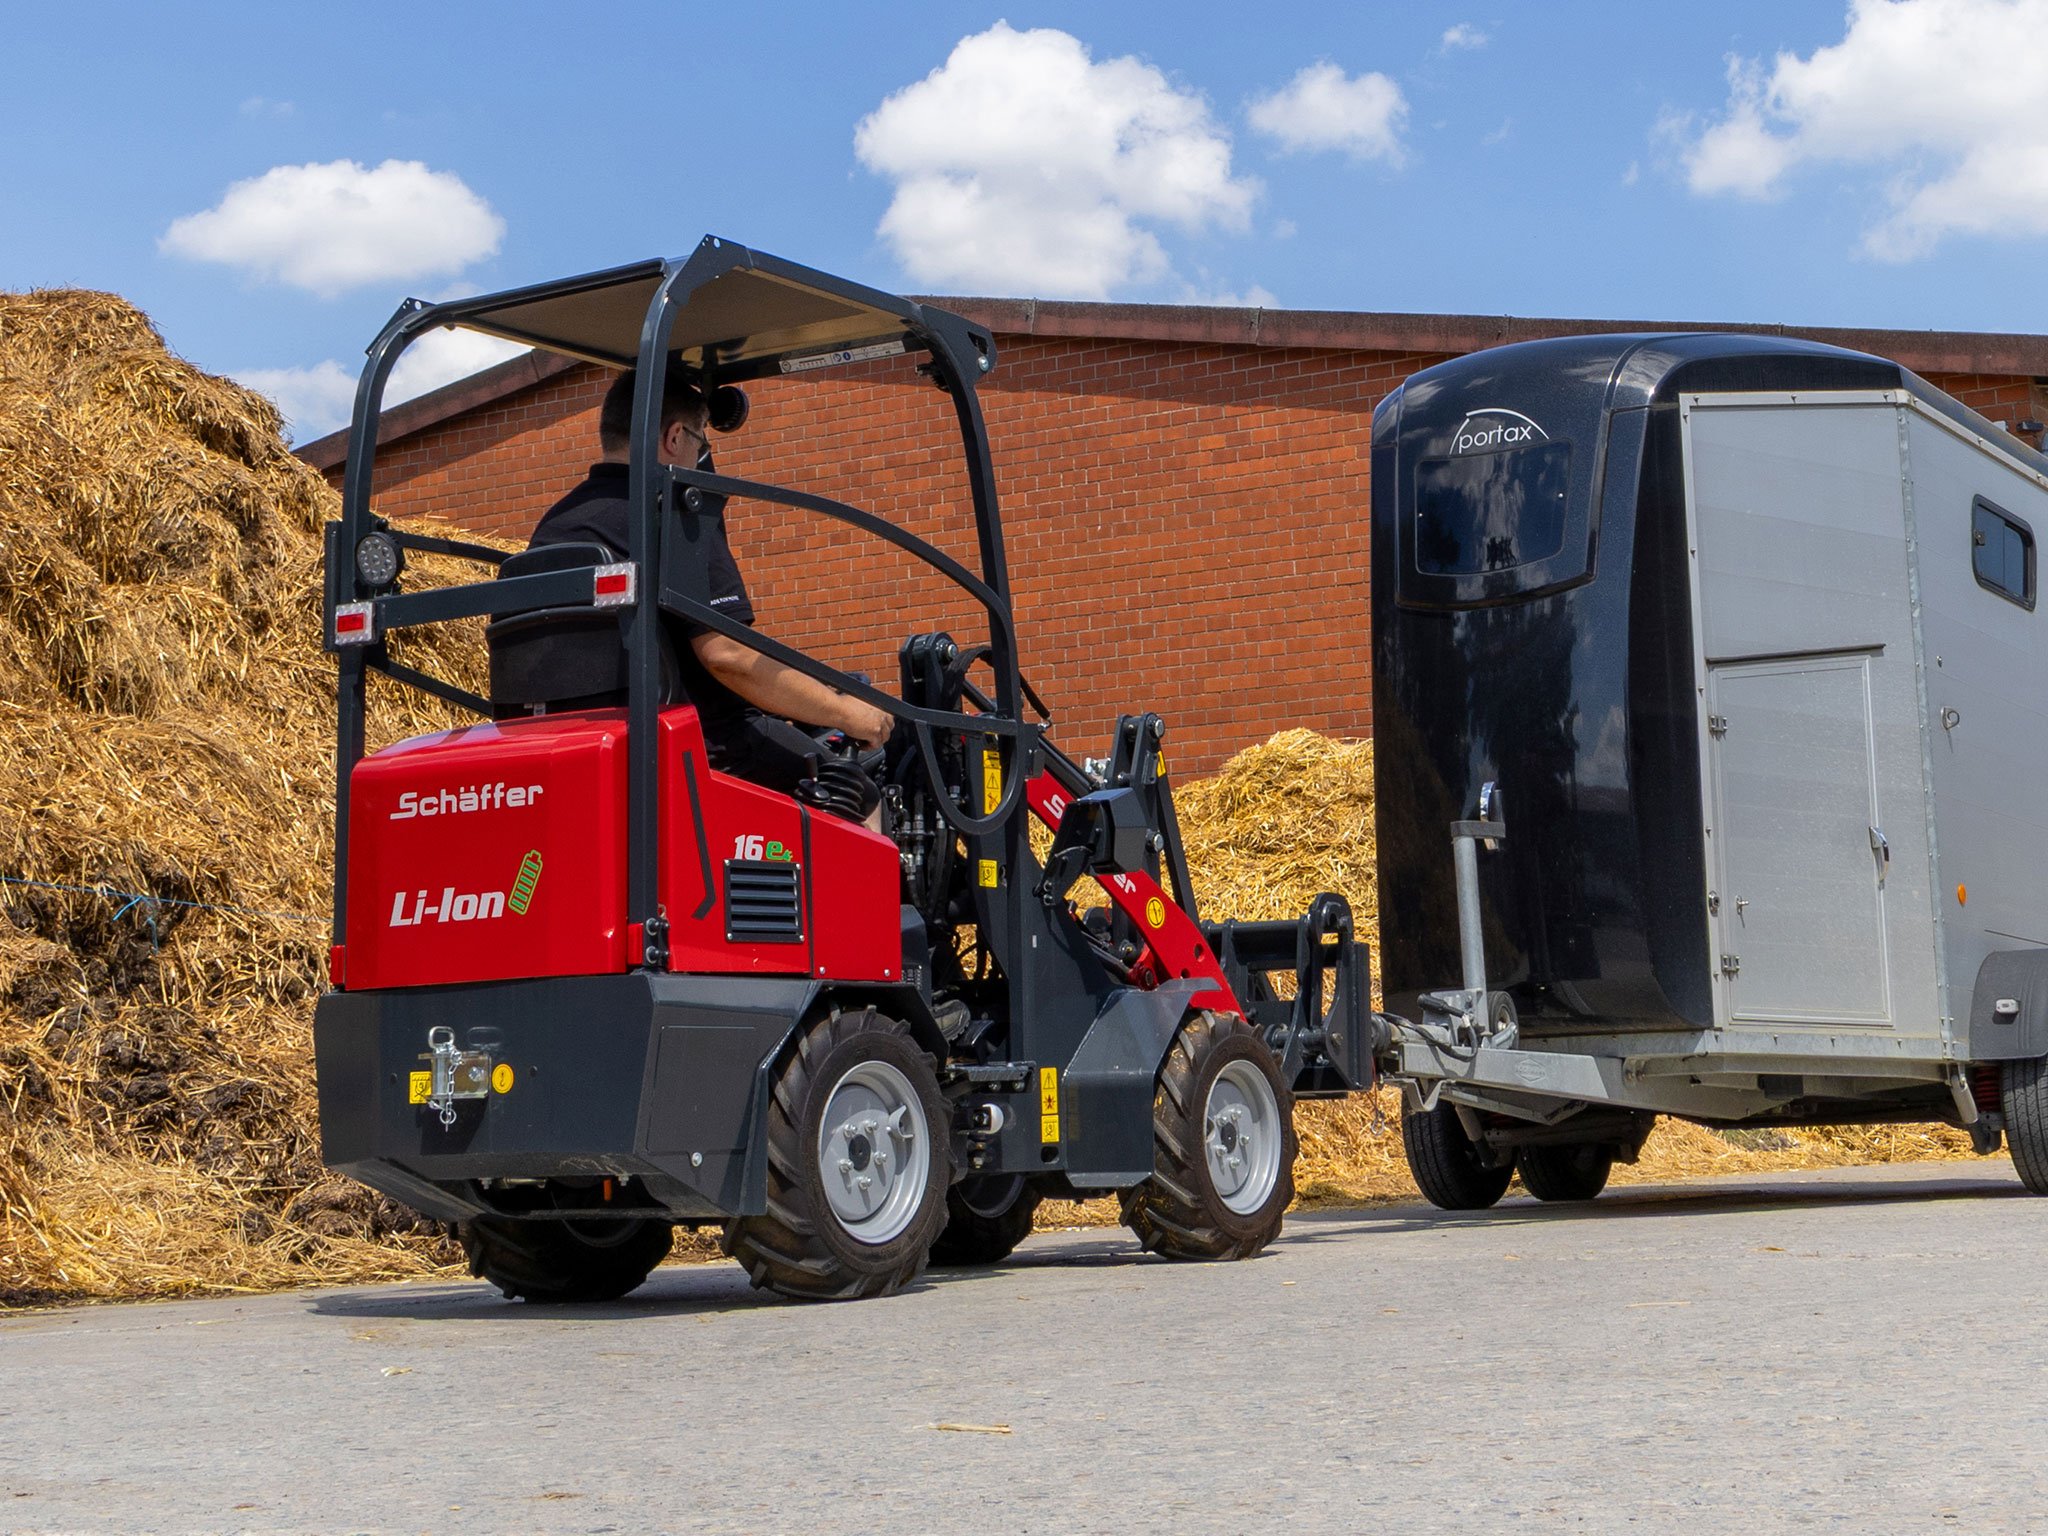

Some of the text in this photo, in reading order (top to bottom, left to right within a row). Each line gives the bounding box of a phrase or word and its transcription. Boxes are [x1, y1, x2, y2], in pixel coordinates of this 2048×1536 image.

[1459, 425, 1532, 454] portax
[389, 782, 543, 820] Schäffer
[389, 887, 505, 927] Li-Ion
